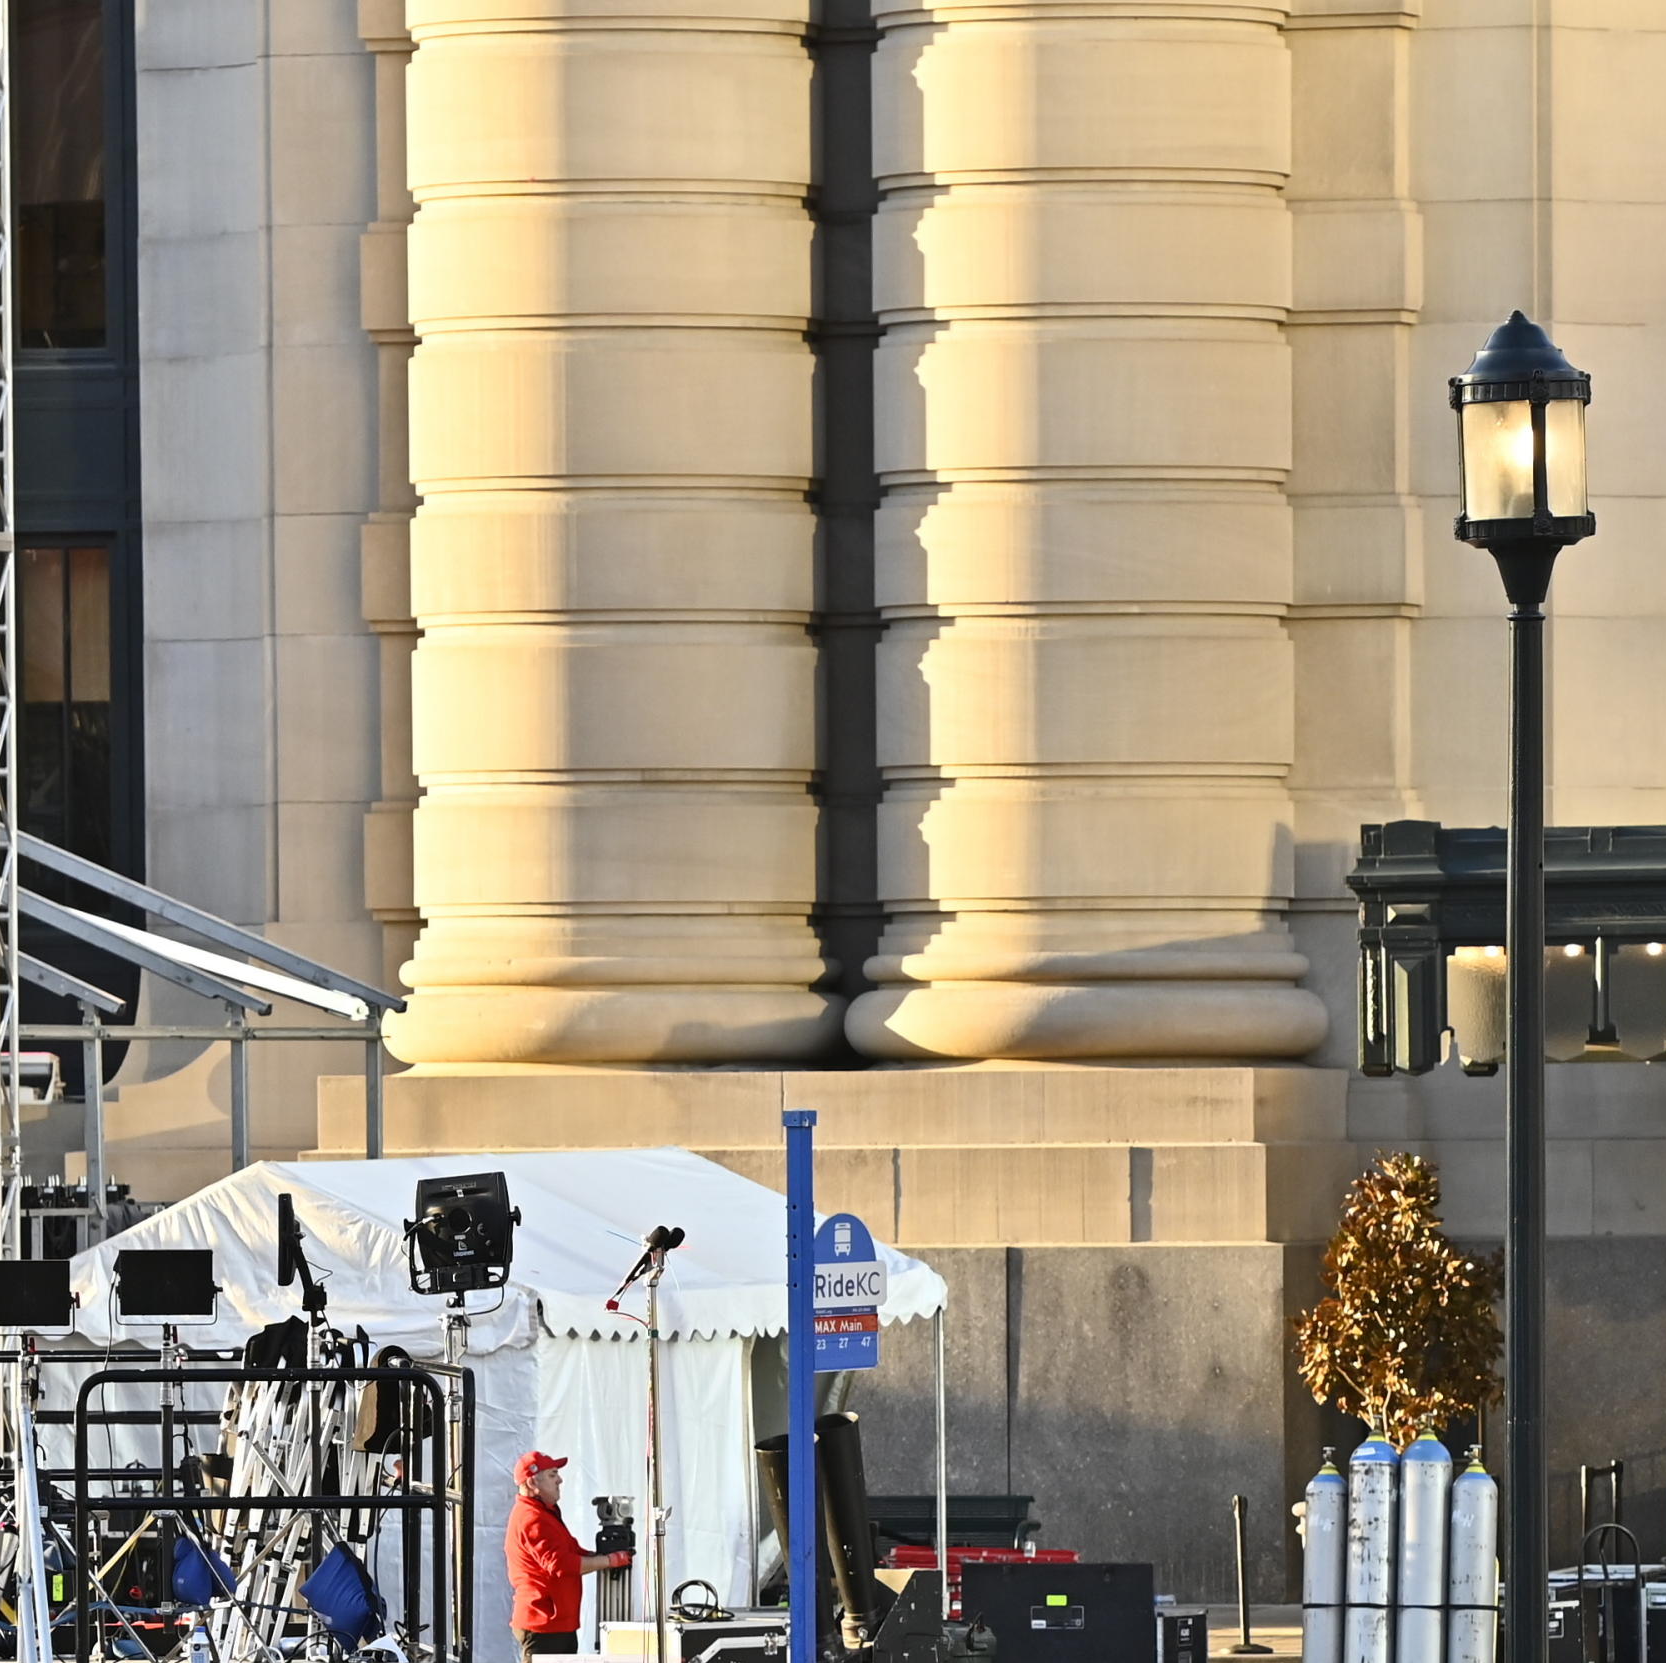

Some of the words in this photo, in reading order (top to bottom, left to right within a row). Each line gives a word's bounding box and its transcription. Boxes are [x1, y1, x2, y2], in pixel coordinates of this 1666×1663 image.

[815, 1271, 880, 1298] RideKC
[814, 1320, 837, 1334] MAX
[839, 1318, 863, 1332] Main
[816, 1339, 826, 1350] 23
[839, 1337, 849, 1349] 27
[861, 1336, 871, 1347] 47
